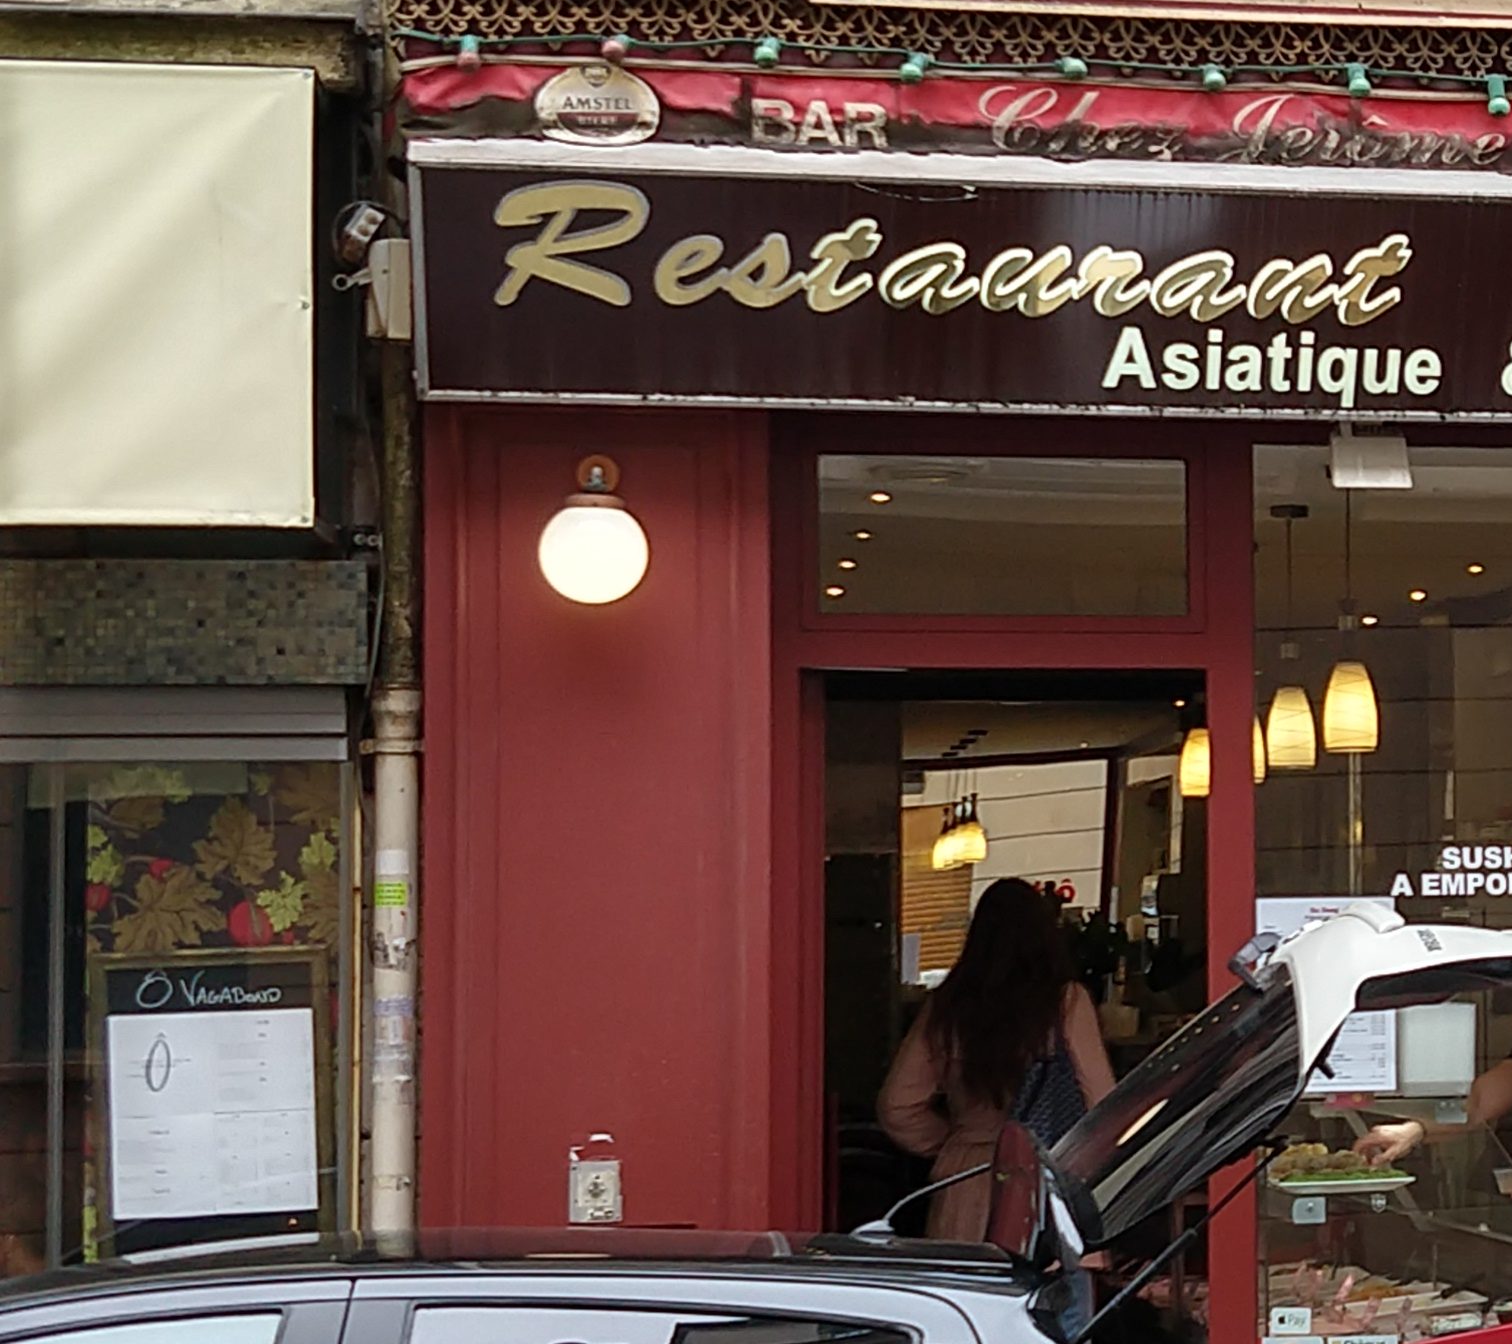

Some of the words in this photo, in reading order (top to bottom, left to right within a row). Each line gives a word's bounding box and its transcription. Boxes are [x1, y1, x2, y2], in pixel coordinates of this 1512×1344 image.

[561, 96, 632, 110] AMSTEL
[751, 98, 888, 148] BAR
[493, 179, 1412, 326] Restaurant
[1102, 325, 1442, 409] Asiatique
[1390, 873, 1414, 897] A
[1288, 1313, 1307, 1327] Pay
